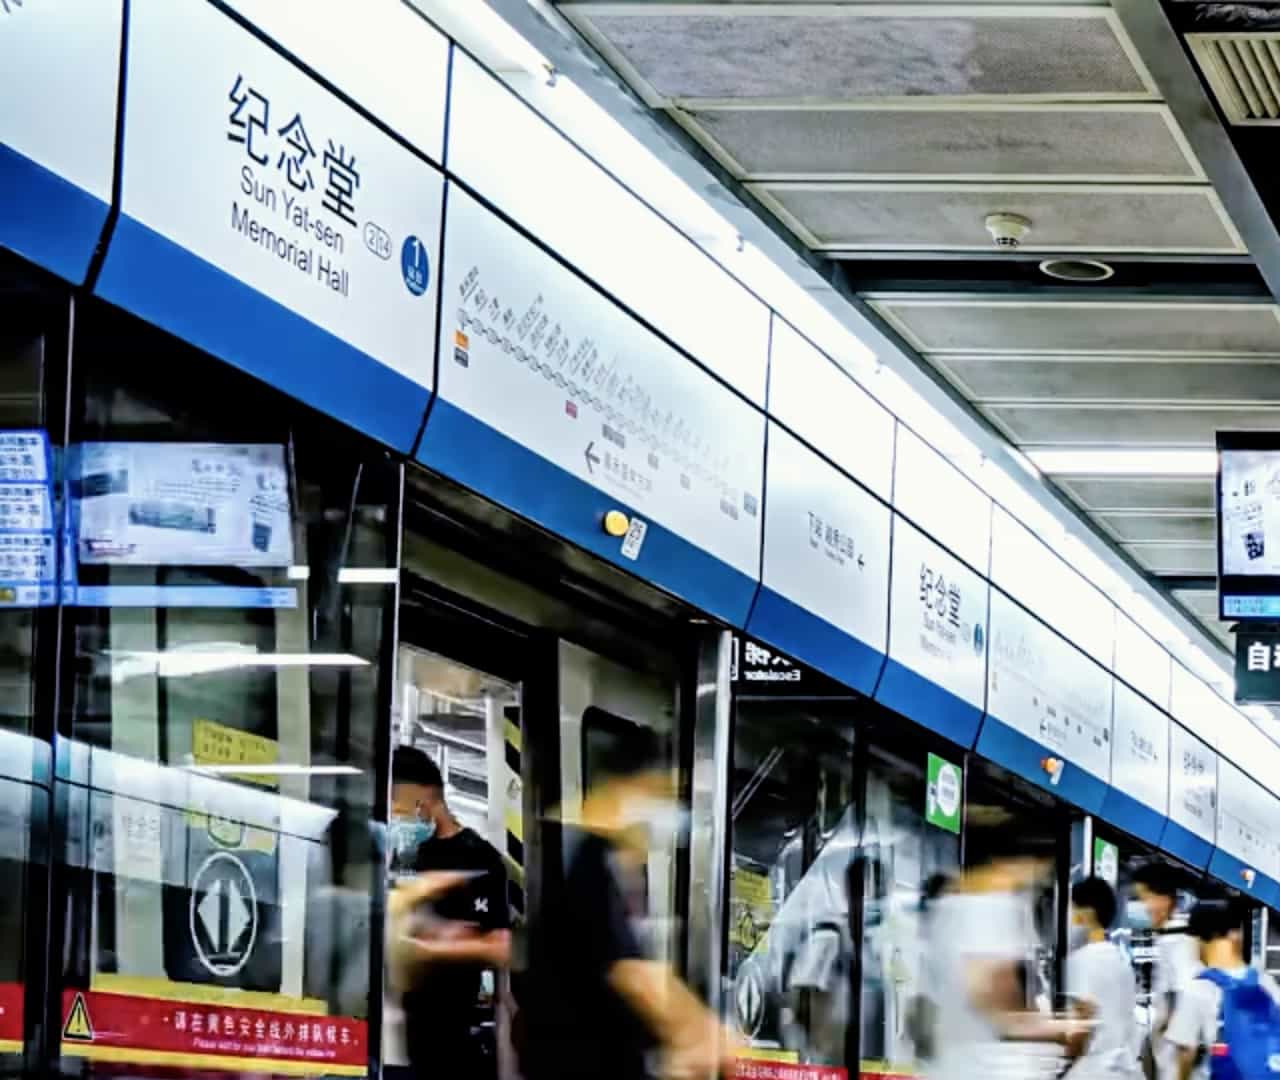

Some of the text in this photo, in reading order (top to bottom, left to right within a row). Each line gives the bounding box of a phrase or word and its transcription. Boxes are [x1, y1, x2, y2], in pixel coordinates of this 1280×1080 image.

[227, 74, 360, 228] 纪念堂
[231, 201, 349, 298] Memorial Hall
[241, 165, 345, 254] Sun Yat-sen
